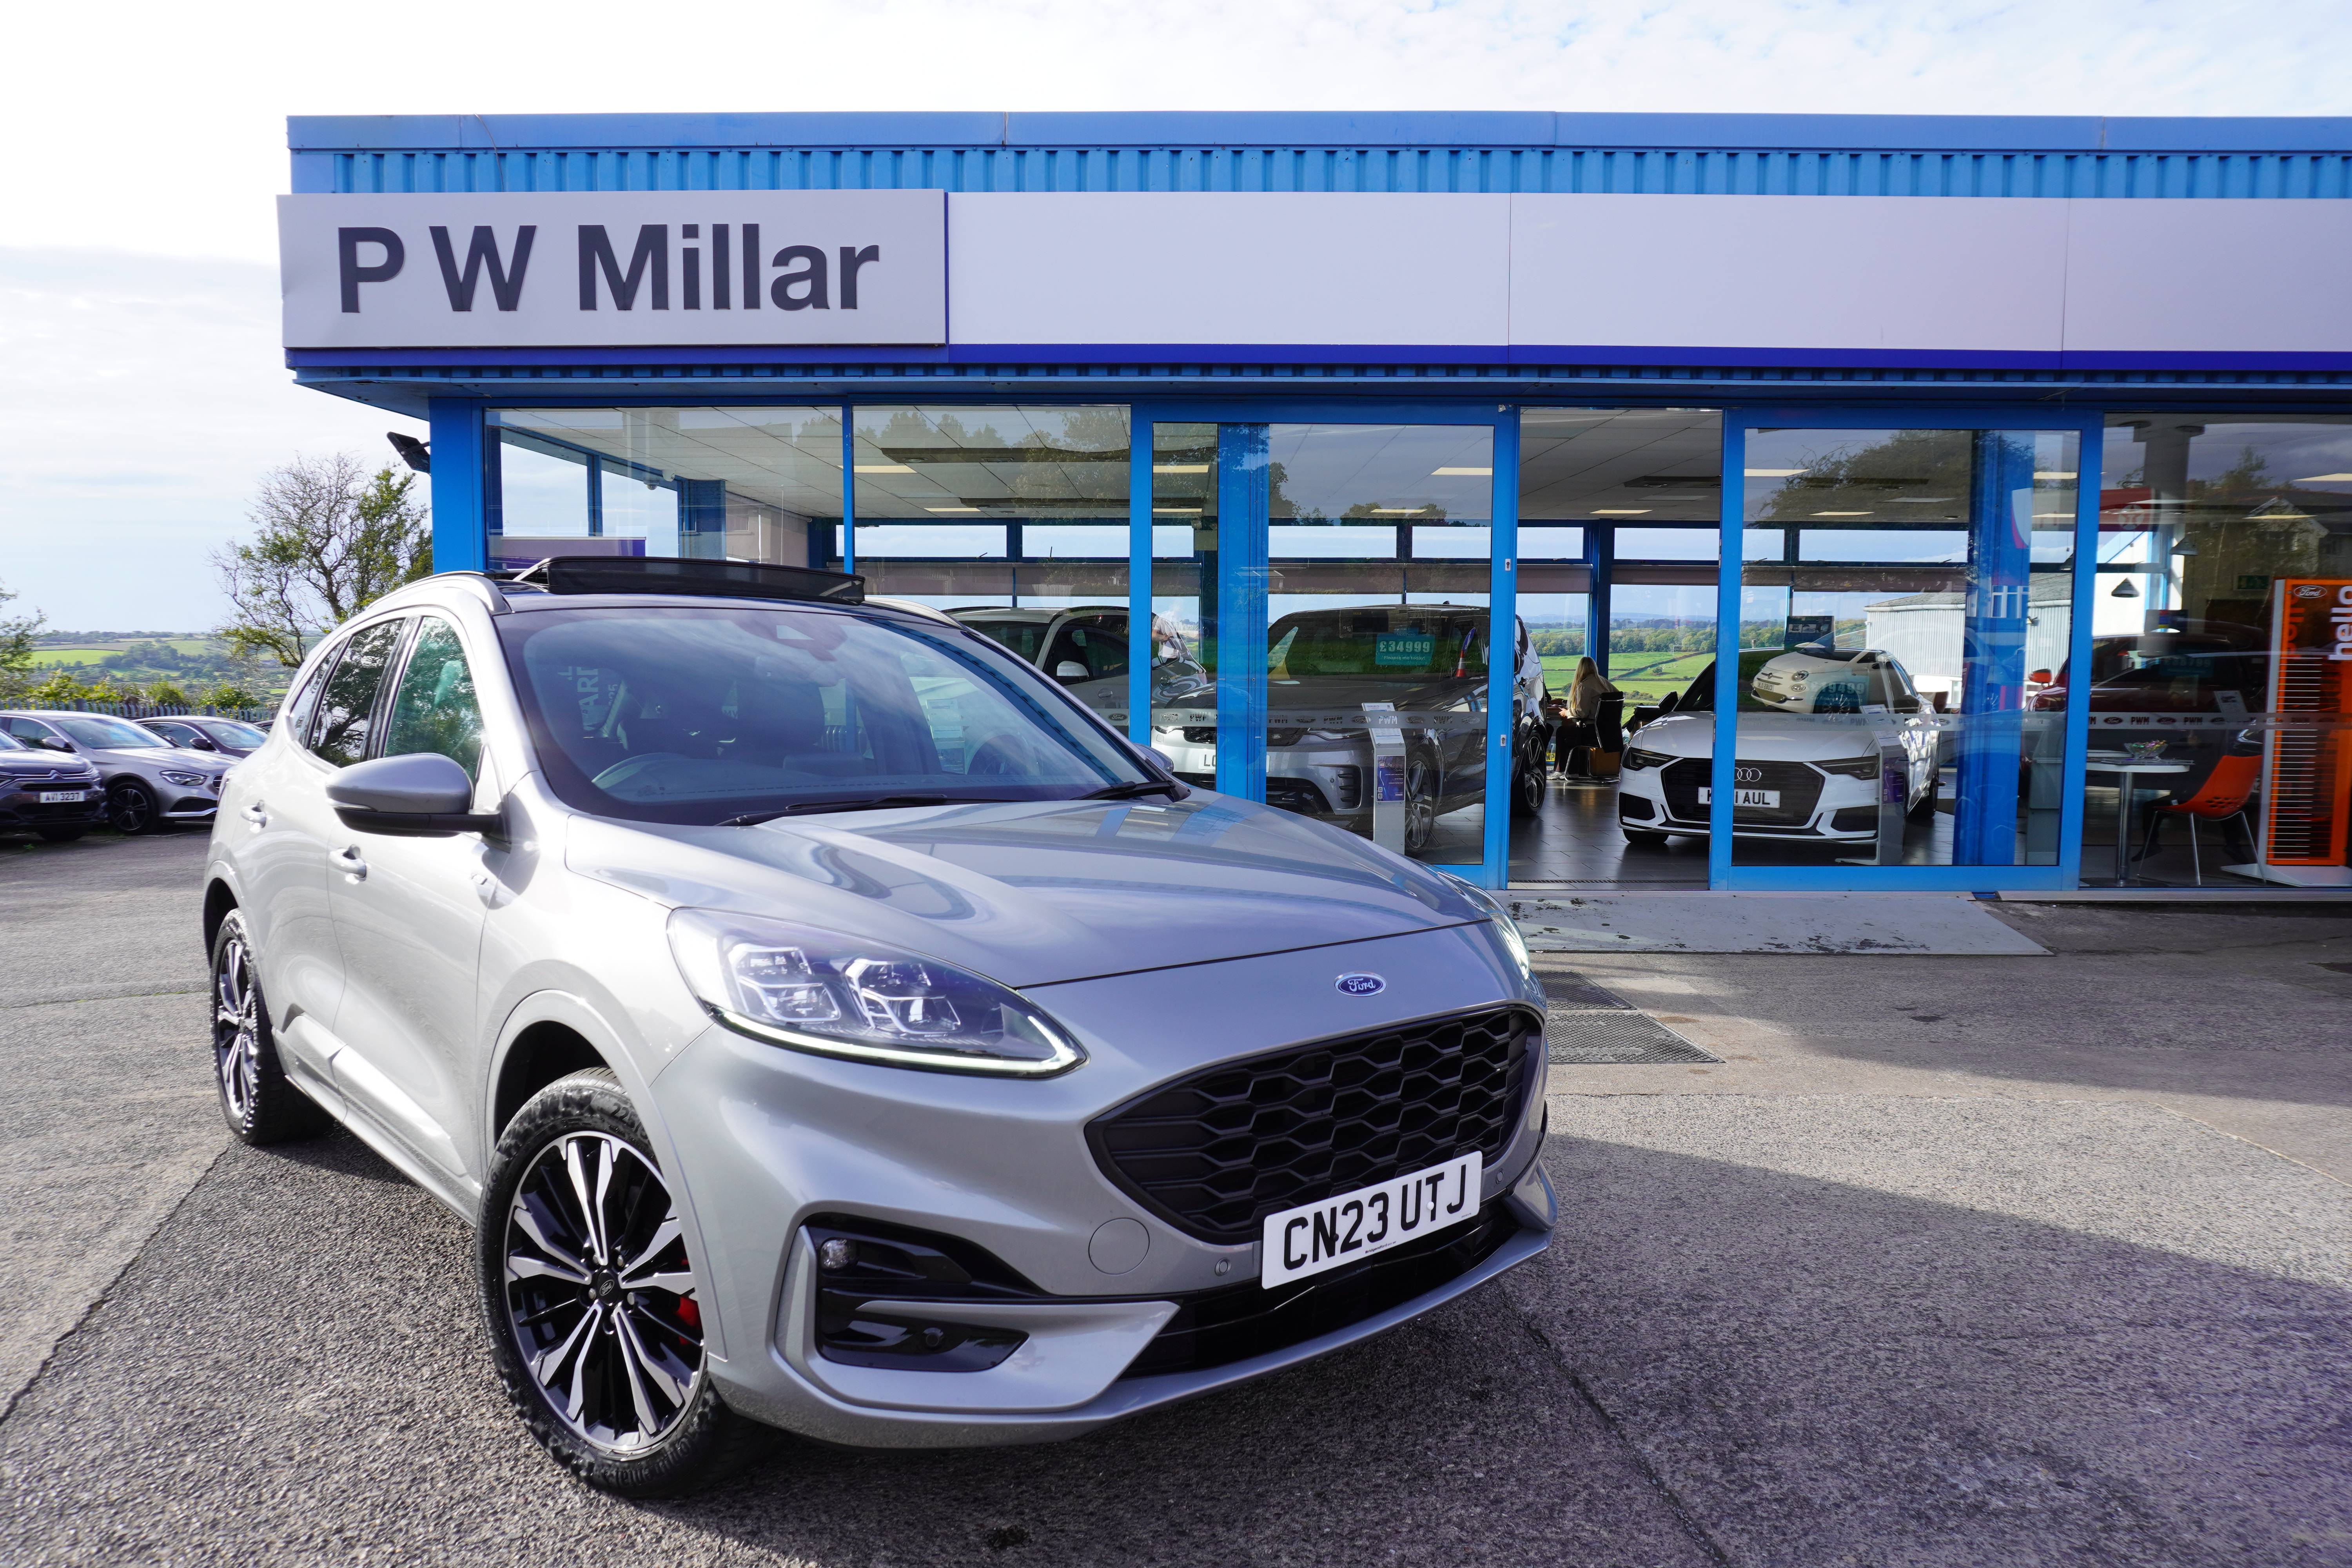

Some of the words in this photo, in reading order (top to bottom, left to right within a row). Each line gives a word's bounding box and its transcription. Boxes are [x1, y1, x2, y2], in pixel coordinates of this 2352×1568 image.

[338, 226, 405, 314] P
[429, 225, 537, 312] W
[578, 223, 880, 311] Millar
[1379, 641, 1430, 653] £34999
[1379, 716, 1397, 724] PWM
[2131, 717, 2150, 725] PWM
[2184, 717, 2203, 725] PWM
[60, 792, 80, 800] 3237
[1743, 791, 1770, 805] AUL
[1284, 1192, 1389, 1270] CN23
[1401, 1164, 1466, 1232] UTJ
